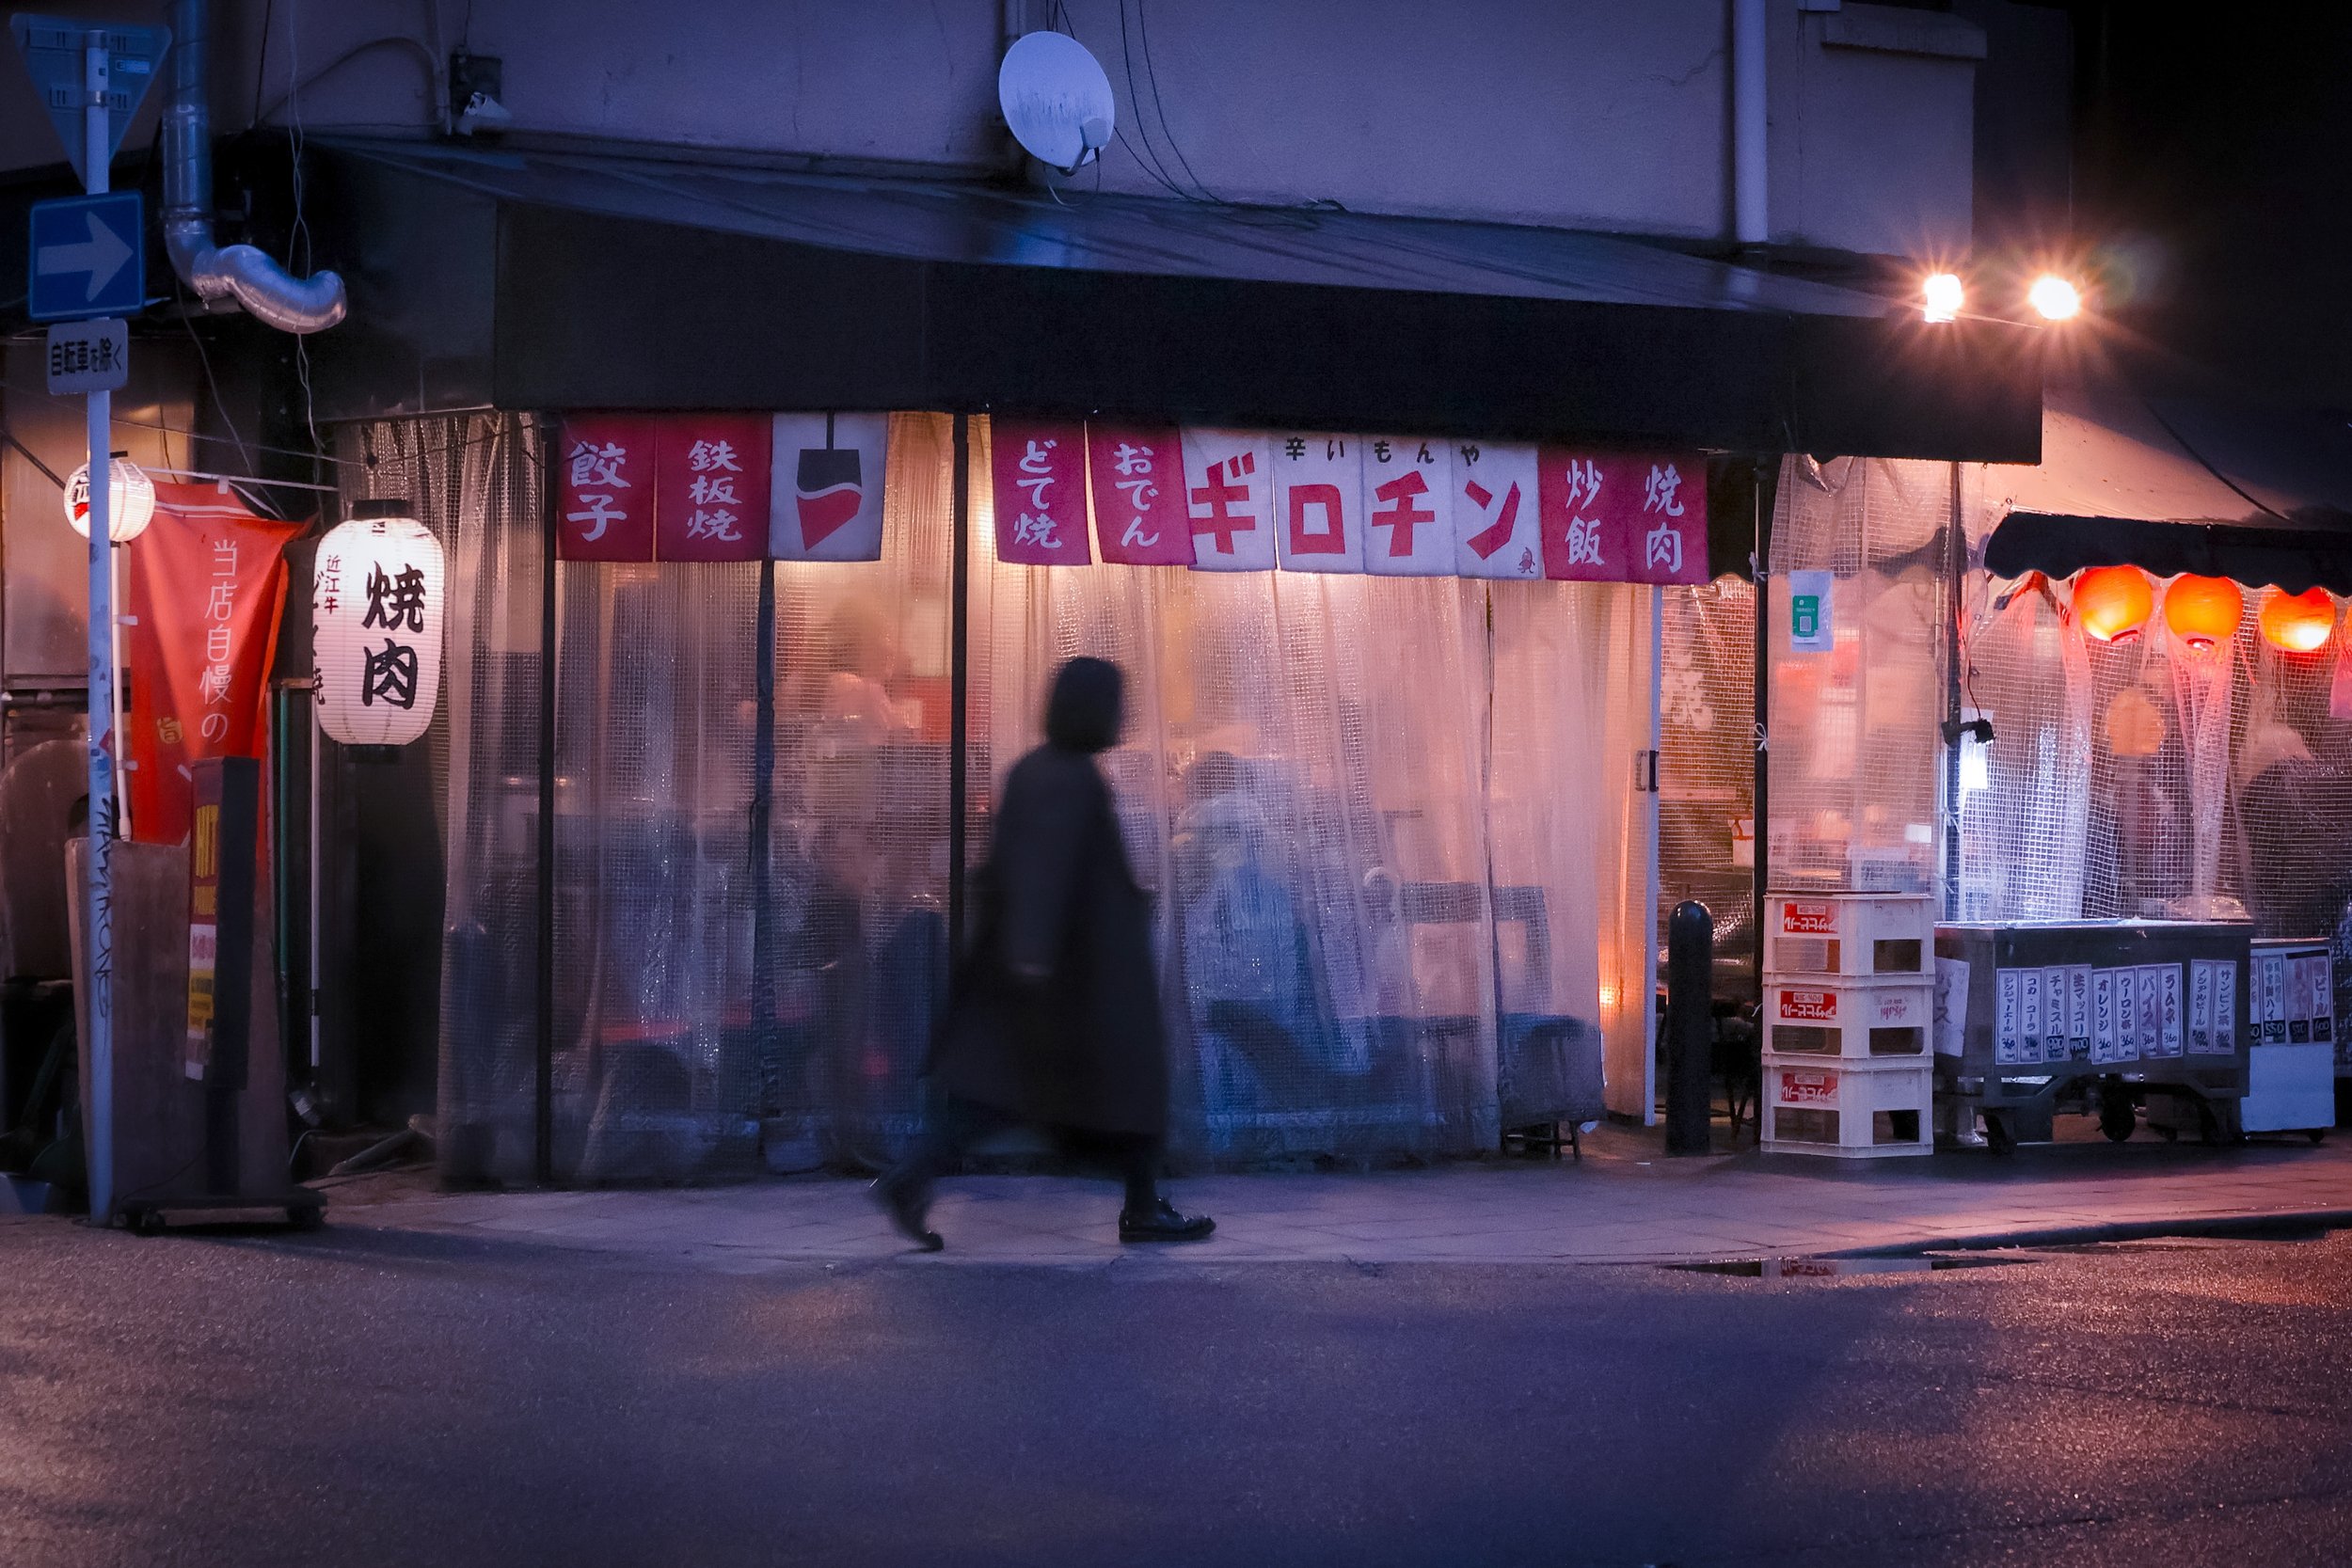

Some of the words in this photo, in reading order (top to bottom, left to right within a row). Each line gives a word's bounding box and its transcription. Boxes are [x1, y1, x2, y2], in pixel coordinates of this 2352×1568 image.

[565, 439, 632, 543] 餃子
[686, 438, 744, 543] 鉄板焼
[1014, 439, 1063, 549] どて焼
[1113, 442, 1160, 547] おでん
[1285, 435, 1481, 465] 辛いもんや
[1190, 451, 1522, 561] ギロチン
[1565, 459, 1605, 566] 炒飯
[1644, 463, 1685, 573] 焼肉
[323, 554, 342, 615] 近江牛
[362, 561, 425, 709] 焼肉
[198, 539, 239, 743] 当店自慢の
[1782, 1004, 1836, 1018] アサヒビール
